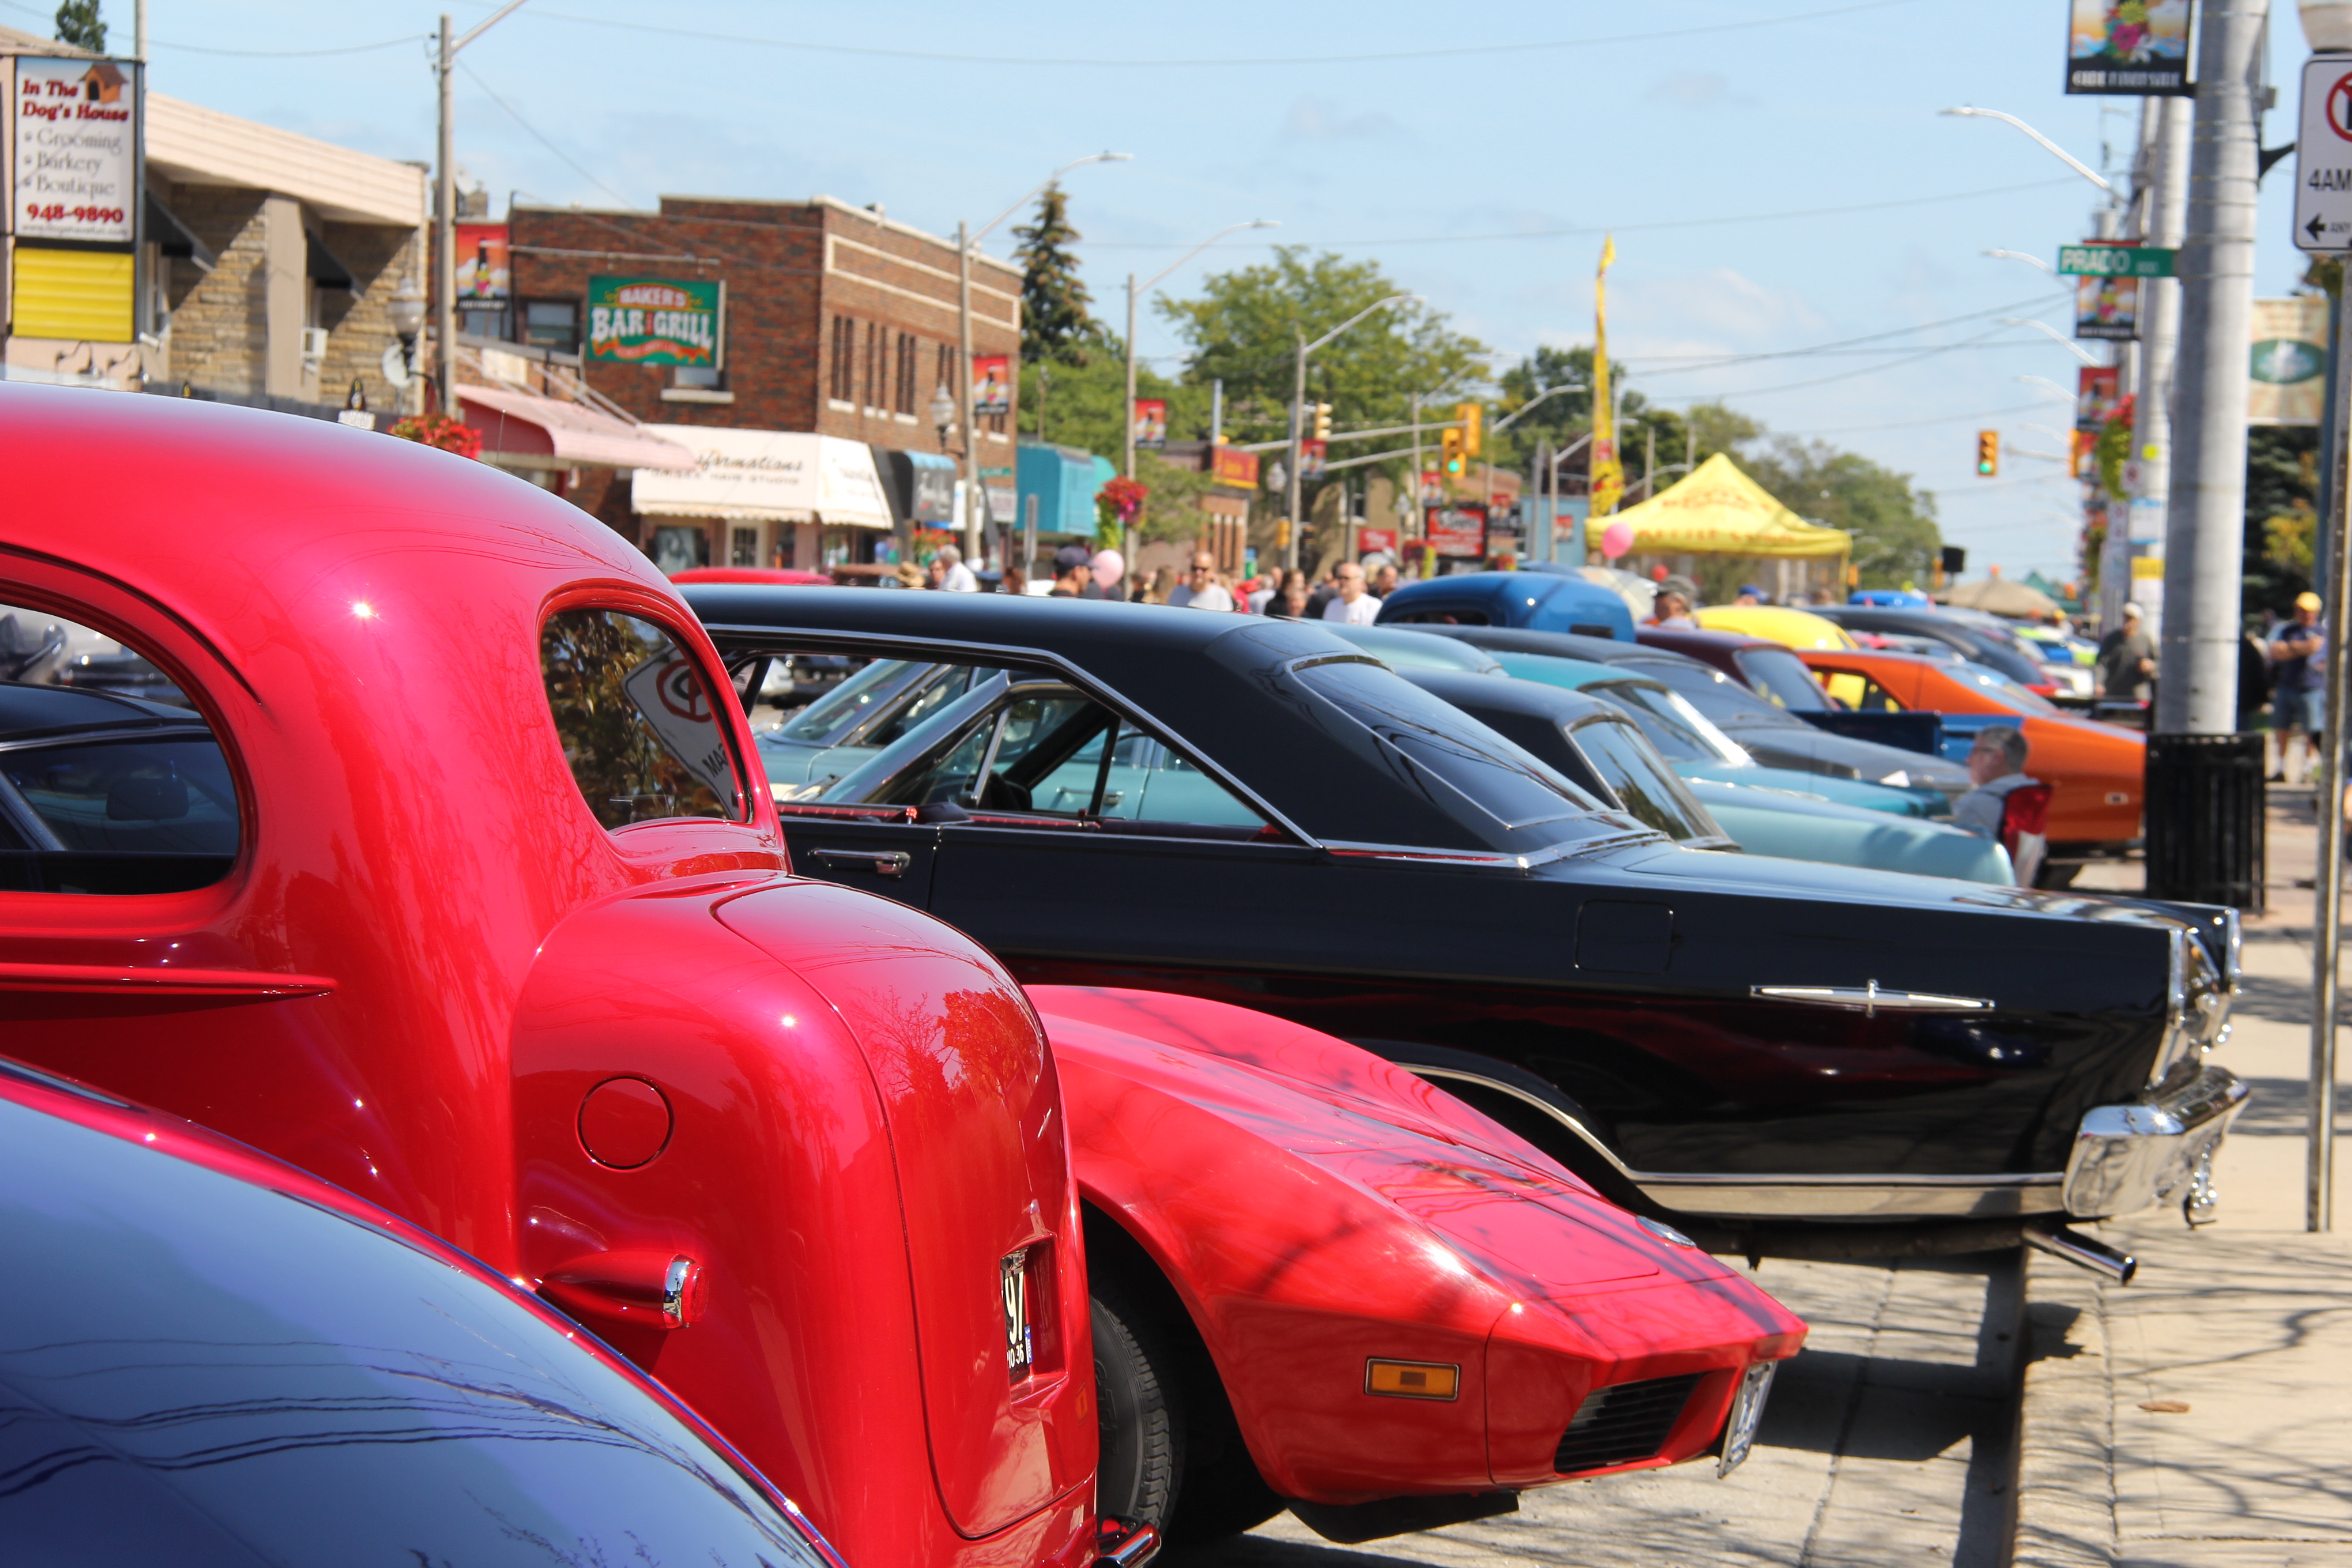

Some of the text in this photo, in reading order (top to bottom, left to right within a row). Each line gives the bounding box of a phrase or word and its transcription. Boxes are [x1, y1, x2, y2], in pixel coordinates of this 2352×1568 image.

[22, 79, 79, 97] In The
[22, 101, 130, 121] Dog's House
[37, 127, 121, 155] Grooming
[37, 174, 116, 201] Boutique
[27, 203, 124, 224] 948-9890
[2061, 248, 2131, 273] PRADO
[590, 306, 644, 342] BAR
[653, 310, 713, 352] GRILL
